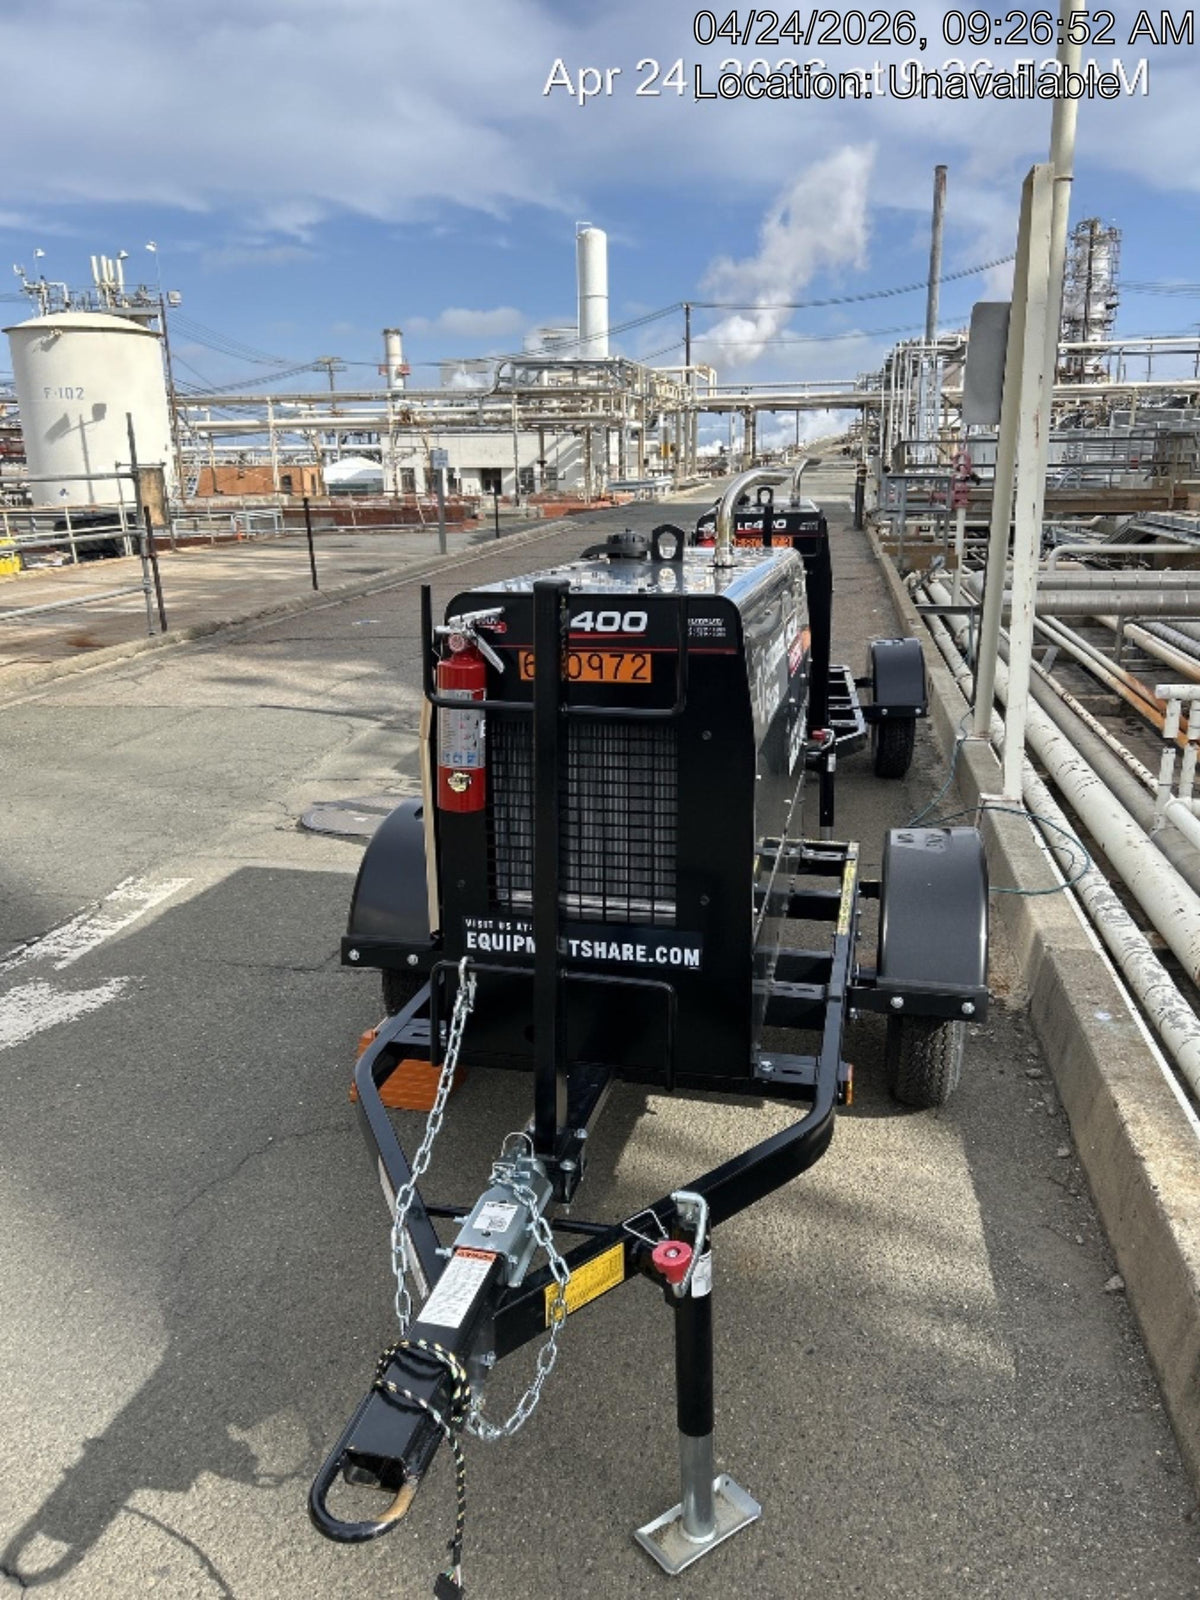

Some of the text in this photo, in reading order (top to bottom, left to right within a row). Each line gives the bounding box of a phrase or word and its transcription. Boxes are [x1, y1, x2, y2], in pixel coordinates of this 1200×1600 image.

[523, 653, 648, 682] 60972
[465, 918, 494, 929] VISIT
[498, 921, 512, 931] US
